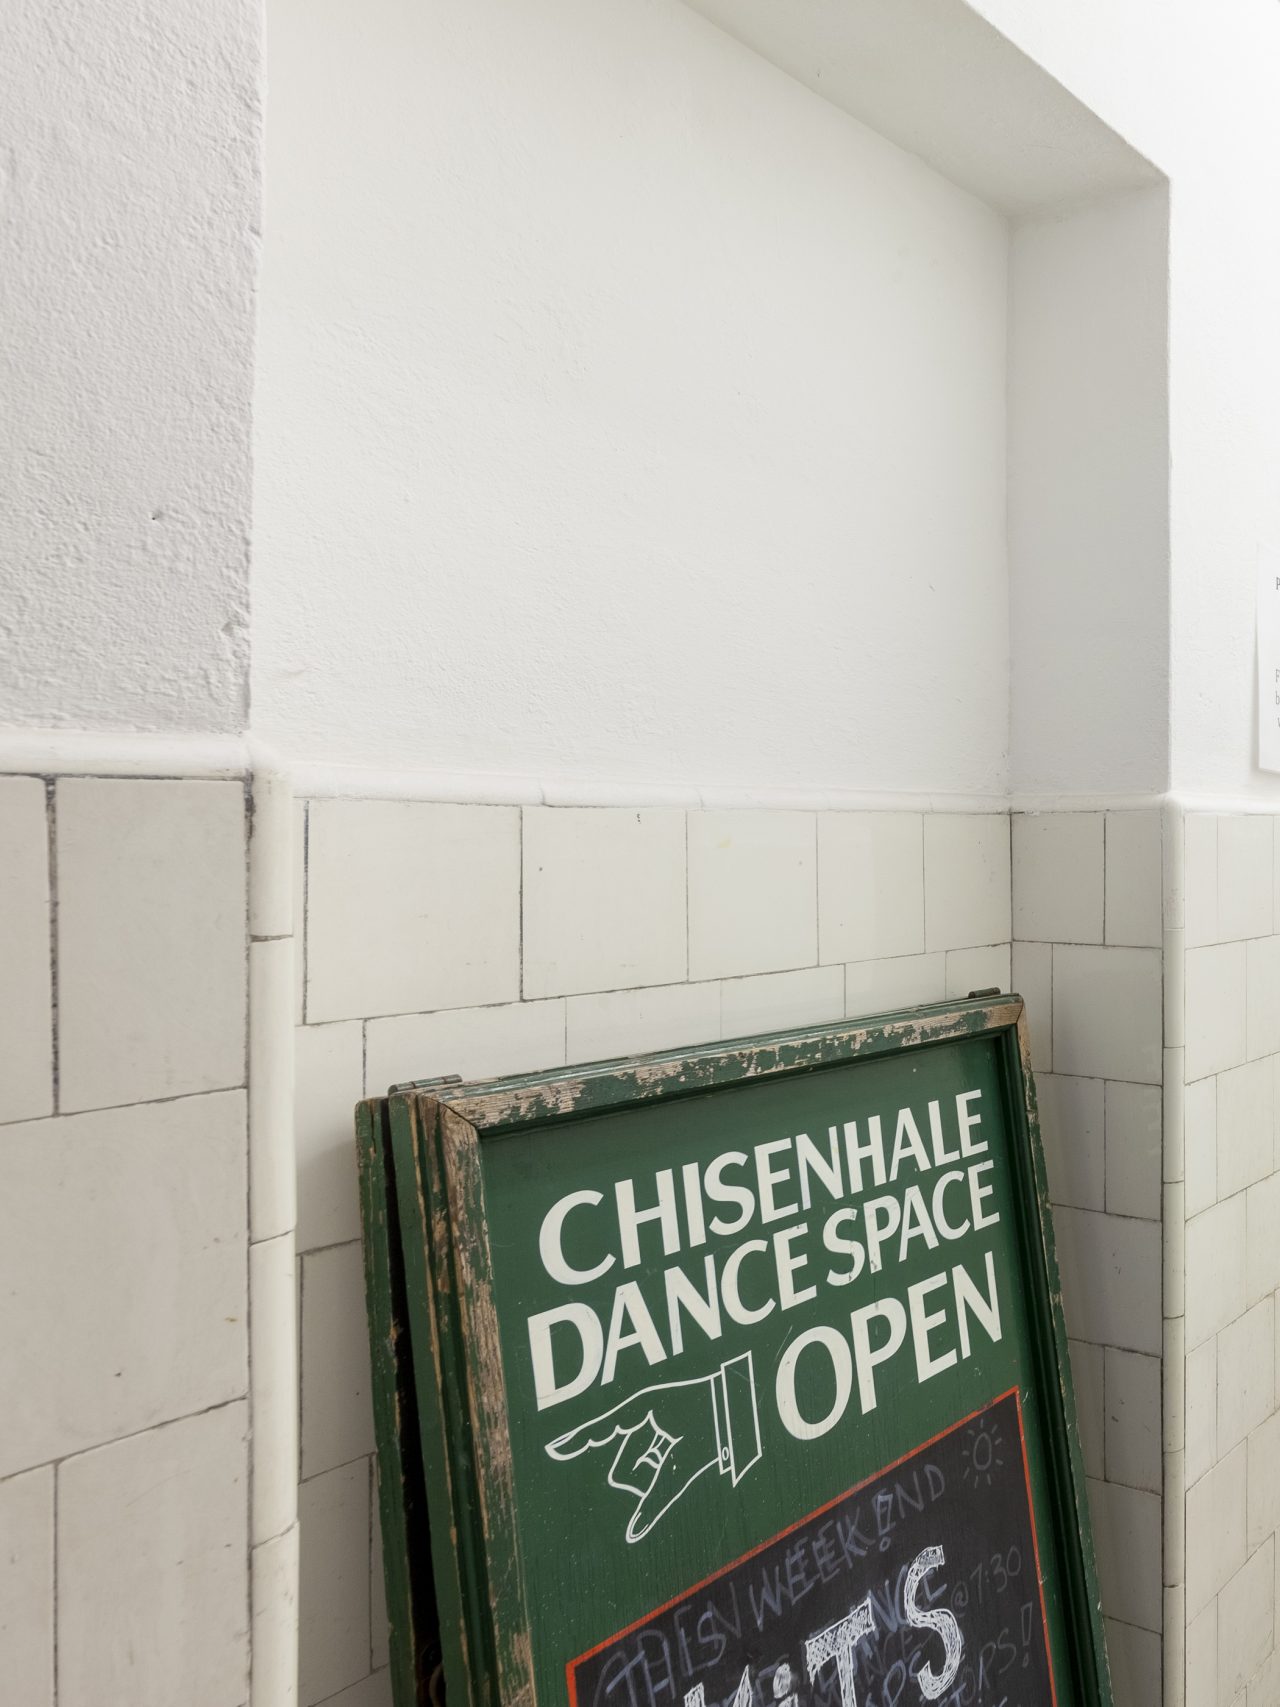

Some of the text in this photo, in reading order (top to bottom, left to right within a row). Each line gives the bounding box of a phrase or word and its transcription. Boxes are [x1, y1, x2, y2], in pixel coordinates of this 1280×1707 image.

[538, 1089, 988, 1285] CHISENHALE
[527, 1160, 1000, 1412] DANCE SPACE
[775, 1251, 1002, 1440] OPEN
